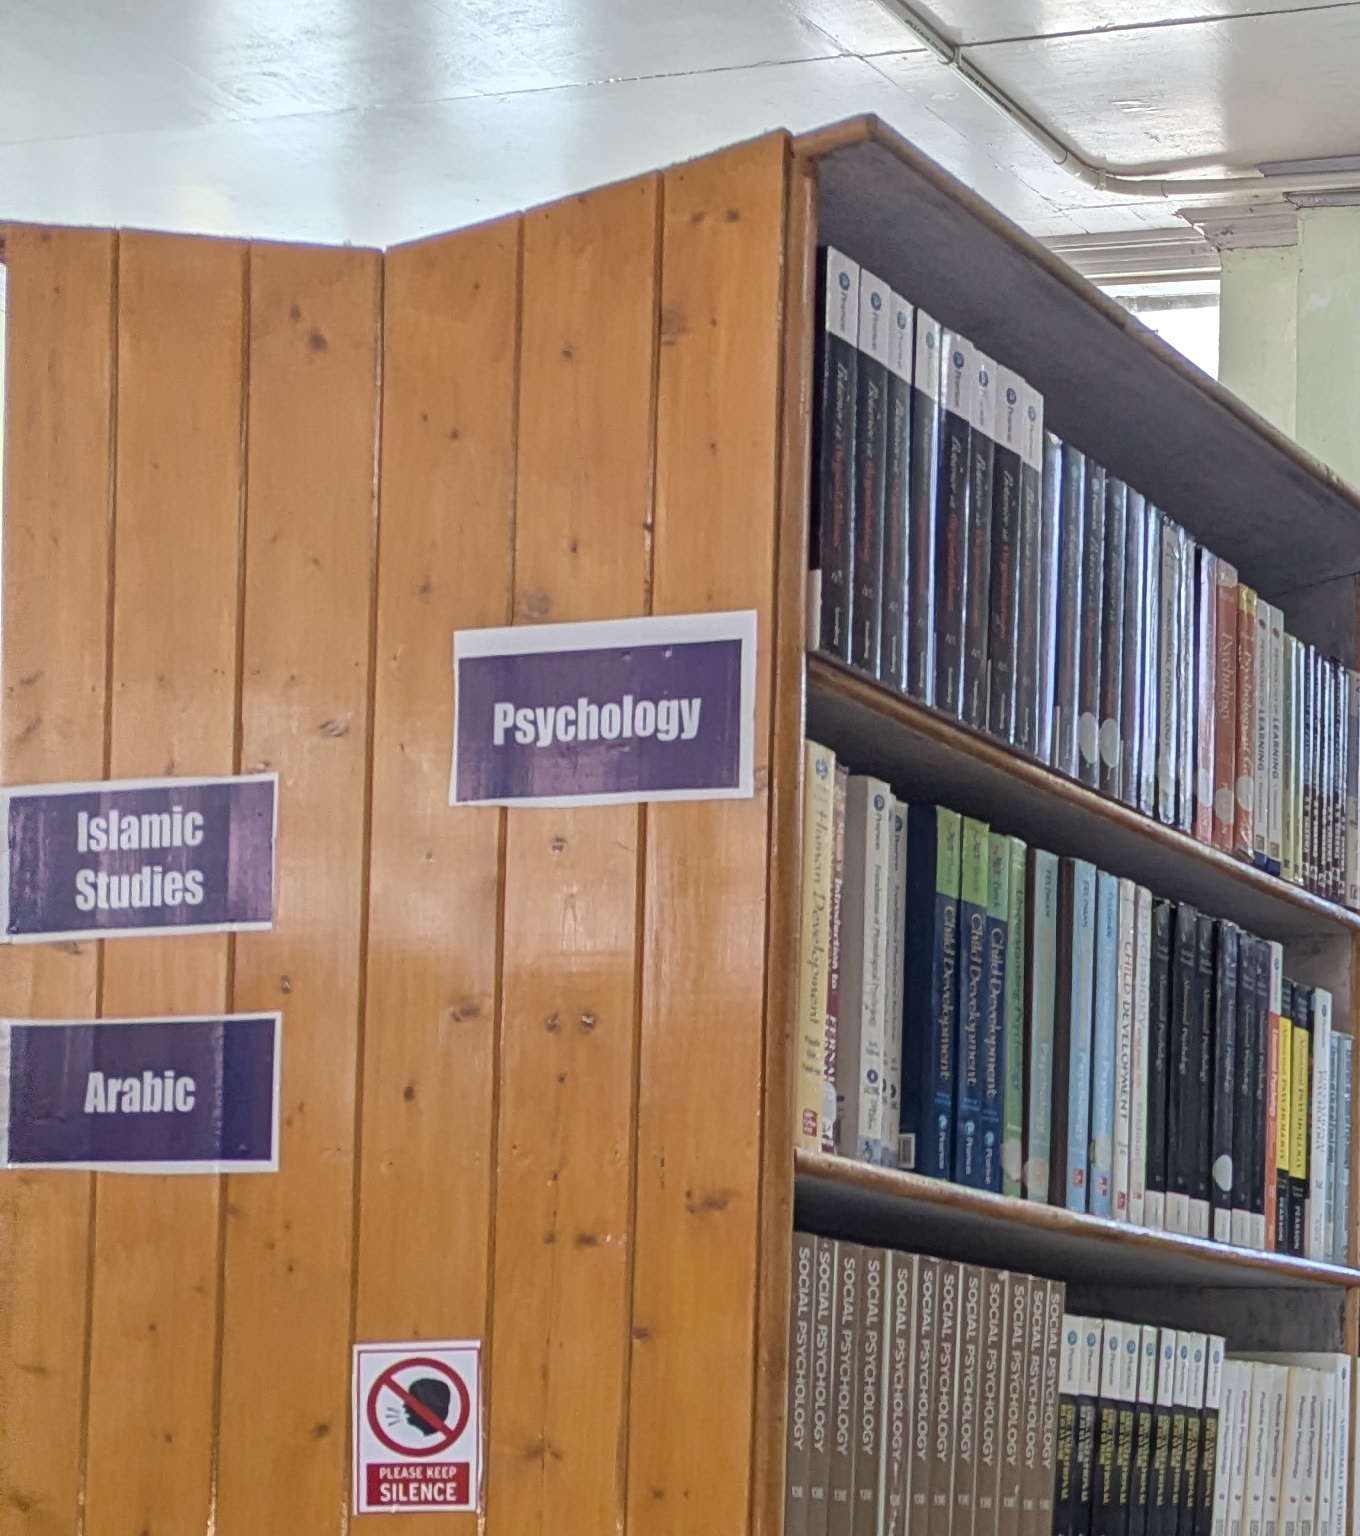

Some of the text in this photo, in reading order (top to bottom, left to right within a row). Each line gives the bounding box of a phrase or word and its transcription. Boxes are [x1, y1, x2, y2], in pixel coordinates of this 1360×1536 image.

[494, 695, 701, 747] Psychology
[77, 806, 204, 852] Islamic
[75, 866, 204, 911] Studies
[84, 1070, 196, 1113] Arabic
[813, 1251, 831, 1452] SOCIAL PSYCHOLOGY
[861, 1260, 880, 1454] SOCIAL PSYCHOLOGY
[936, 1274, 955, 1461] SOCIAL PSYCHOLOGY
[1007, 1284, 1025, 1465] SOCIAL PSYCHOLOGY
[380, 1466, 457, 1479] PLEASE KEEP
[380, 1482, 457, 1502] SILENCE
